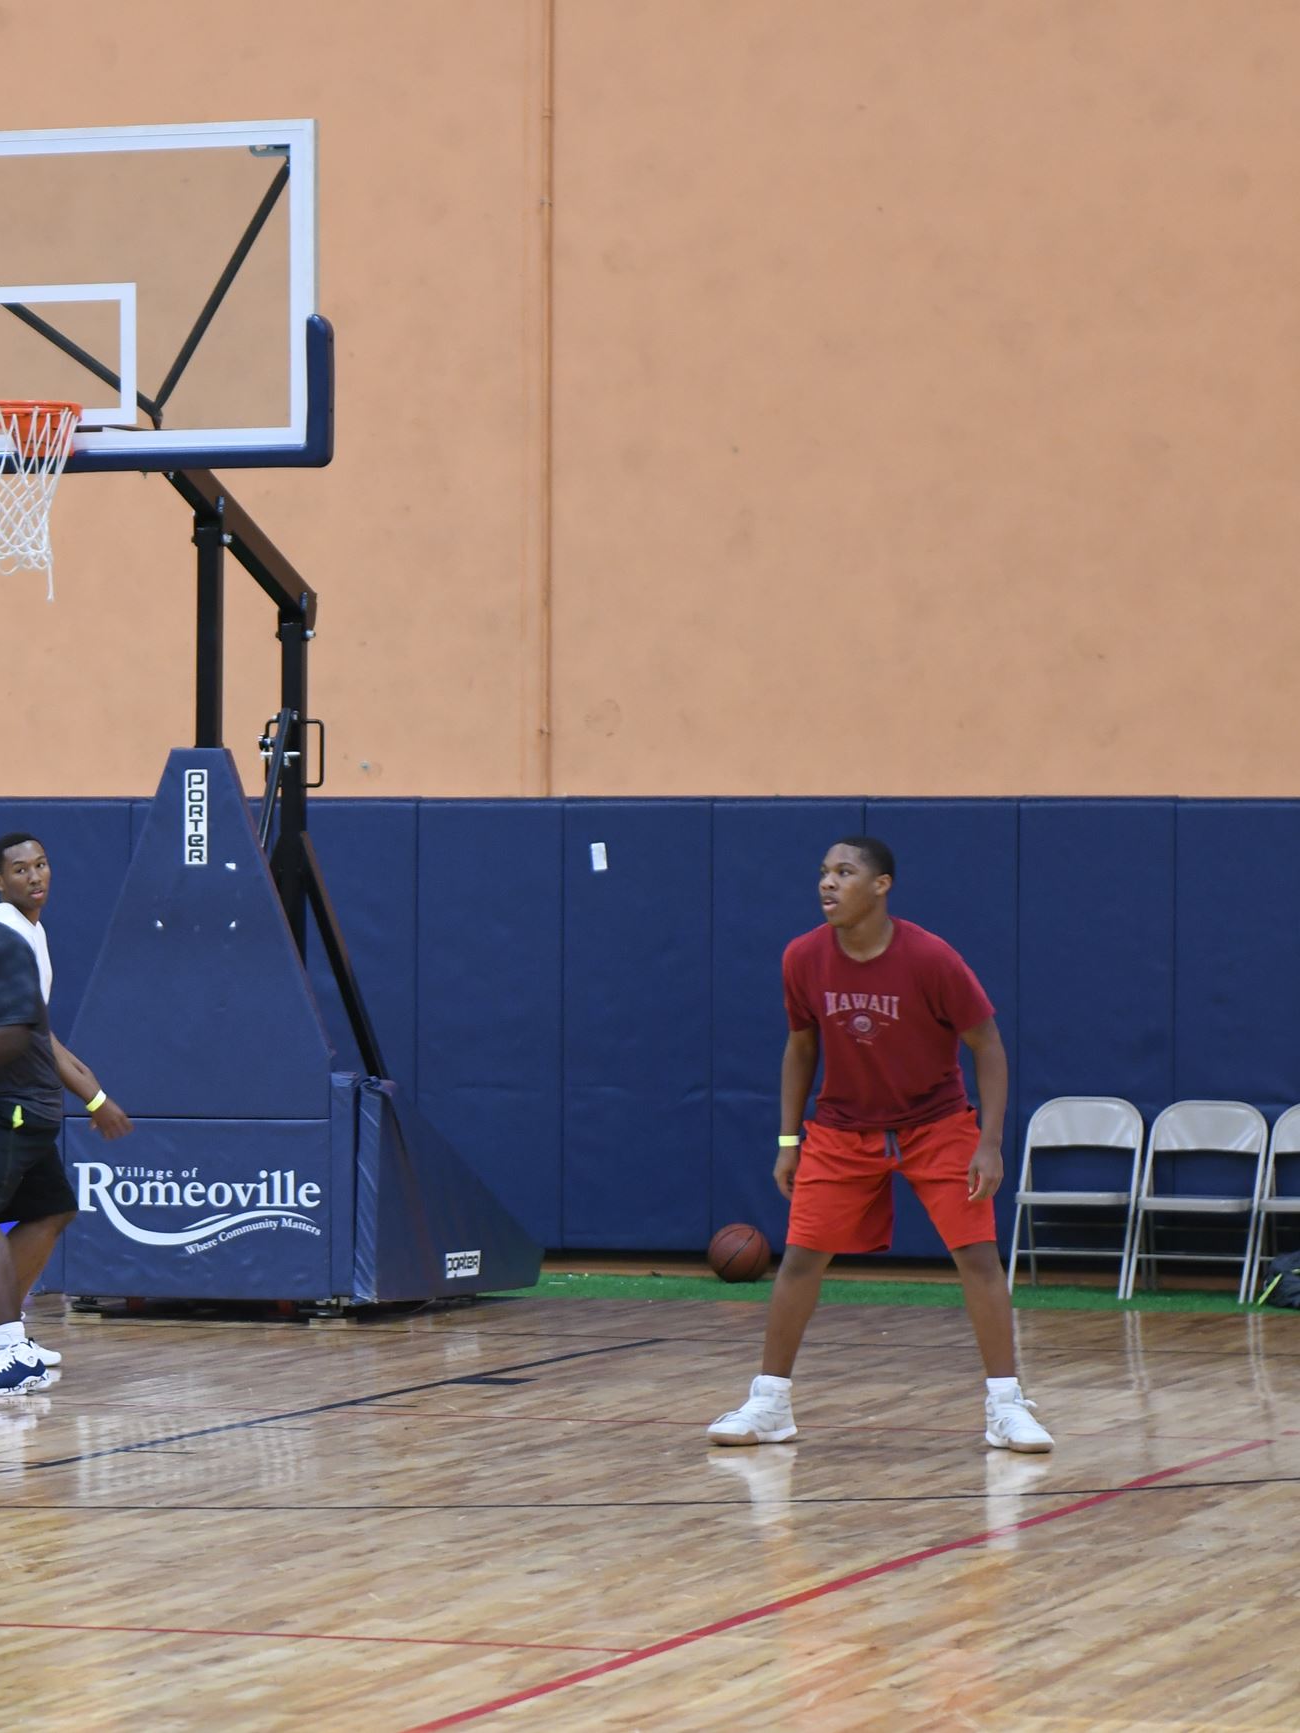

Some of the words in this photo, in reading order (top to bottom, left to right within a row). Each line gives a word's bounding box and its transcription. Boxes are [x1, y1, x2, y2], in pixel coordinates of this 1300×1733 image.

[824, 991, 900, 1020] HAWAII
[73, 1162, 322, 1212] Romeoville
[115, 1166, 174, 1180] Village
[181, 1167, 199, 1178] of
[185, 1238, 218, 1255] Where
[218, 1218, 279, 1241] Community
[281, 1217, 322, 1236] Matters
